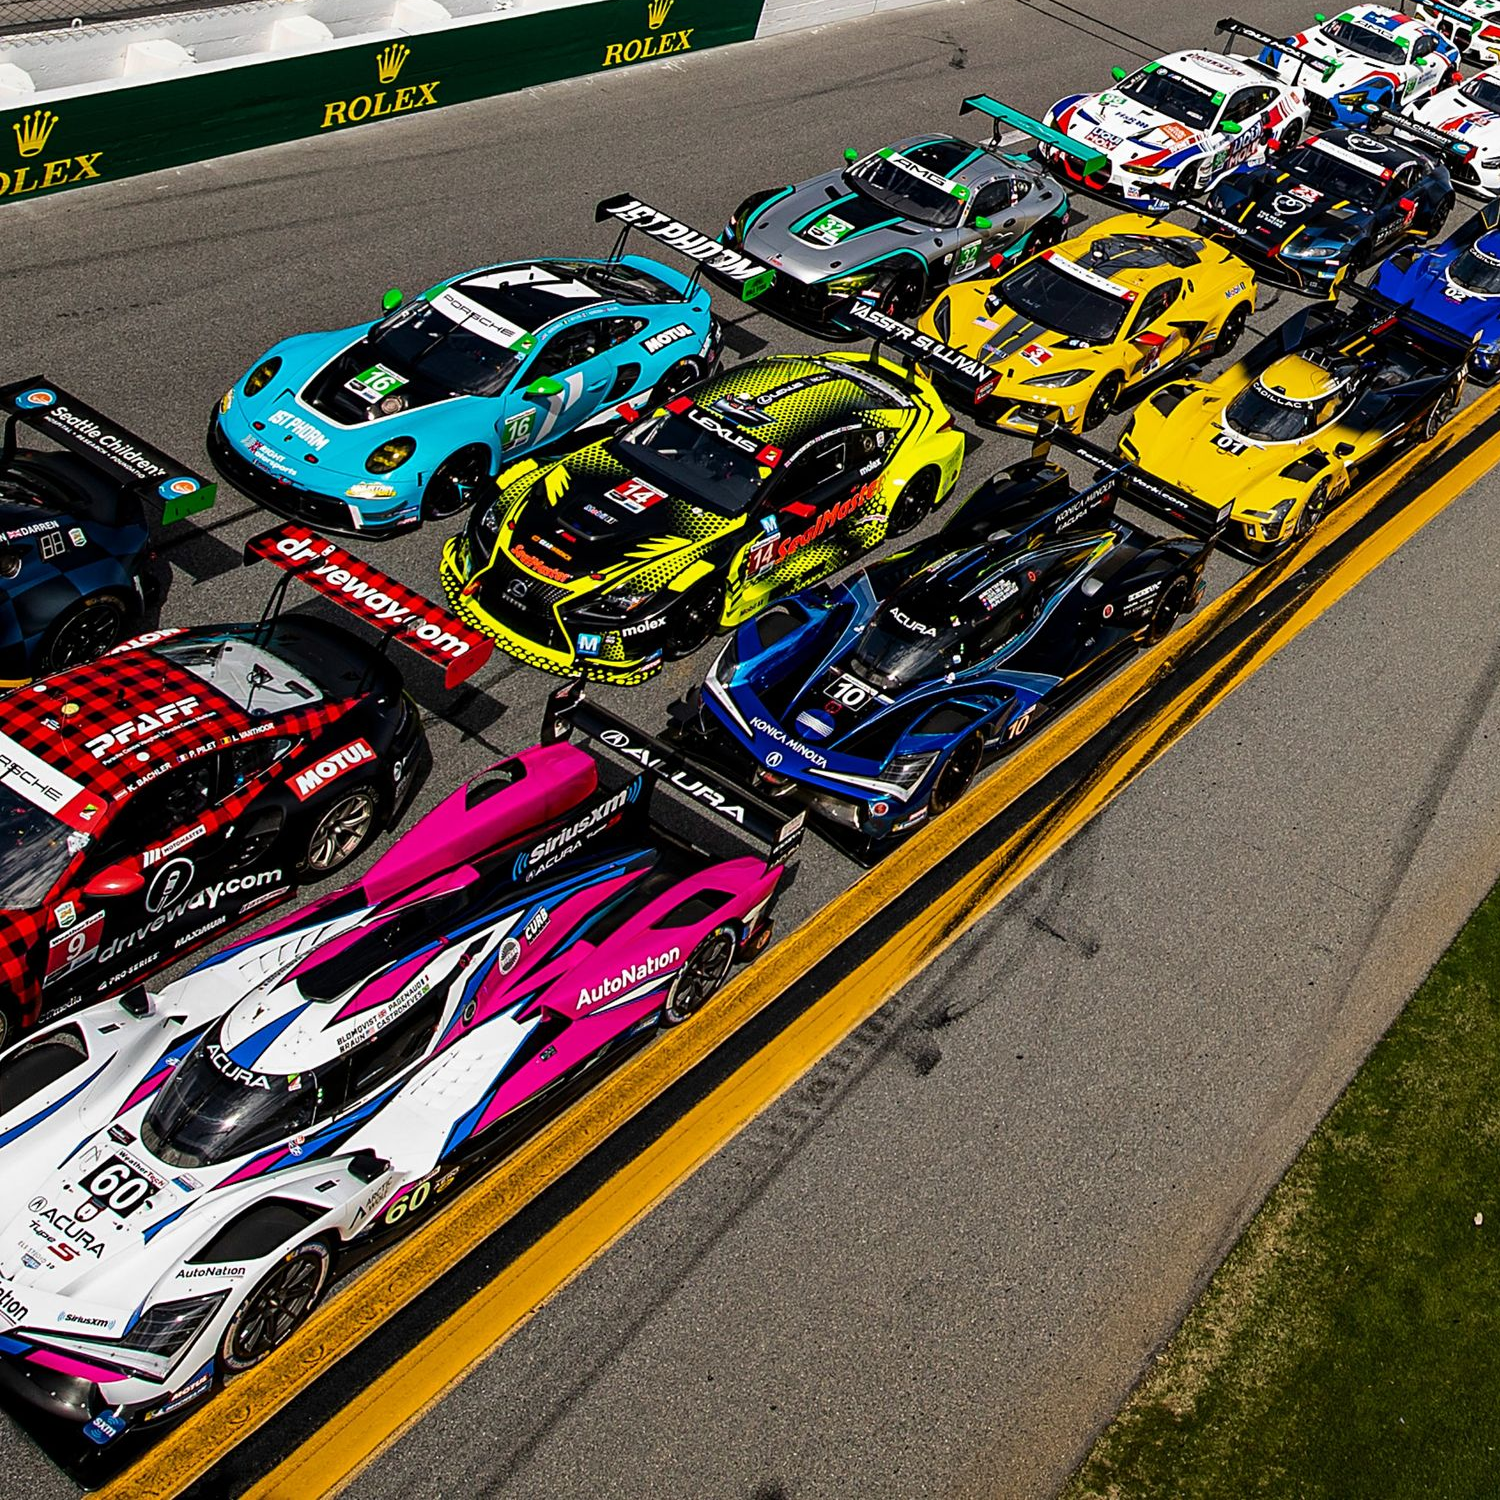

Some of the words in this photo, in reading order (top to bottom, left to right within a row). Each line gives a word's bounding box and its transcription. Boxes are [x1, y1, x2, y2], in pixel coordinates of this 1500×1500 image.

[603, 28, 692, 66] ROLEX
[320, 81, 440, 129] ROLEX
[1085, 133, 1118, 152] MOLY
[1092, 126, 1124, 145] LIQUI
[0, 152, 103, 197] LEX
[890, 156, 948, 187] AMG
[818, 218, 844, 237] 32
[960, 244, 977, 263] 32
[1444, 287, 1464, 302] 02
[441, 293, 517, 339] PORSCHE
[848, 300, 915, 341] VASSER
[645, 324, 693, 353] MOTUL
[1033, 346, 1046, 360] 3
[364, 370, 397, 392] 16
[769, 381, 804, 399] LEXUS
[1252, 381, 1303, 410] CADILLAC
[51, 405, 101, 439] Seattle
[285, 413, 331, 451] PHORM
[508, 415, 531, 442] 16
[687, 409, 759, 454] LEXUS
[44, 415, 73, 434] HOSPITAL
[75, 434, 109, 455] RESEARCH
[109, 454, 147, 480] FOUNDATIO
[1217, 434, 1249, 454] 01
[860, 457, 882, 477] molex
[624, 483, 650, 505] 14
[20, 520, 60, 537] DARREN
[764, 518, 778, 534] M
[774, 476, 886, 565] SealMaster
[753, 543, 774, 571] 14
[275, 536, 471, 658] drveway.om
[621, 615, 667, 638] molex
[889, 605, 938, 638] ACURA
[104, 627, 182, 657] MOTU
[835, 681, 866, 707] 10
[85, 696, 200, 759] PFAFF
[237, 722, 276, 741] VANTHOOR
[1008, 714, 1030, 739] 10
[195, 740, 217, 756] PILET
[750, 715, 787, 744] KONICA
[785, 736, 828, 770] MINOLTA
[0, 754, 63, 801] RSCHE
[136, 761, 173, 788] BACHLER
[295, 742, 372, 798] MOTUL
[163, 827, 205, 854] MOTOMASTER
[535, 839, 583, 877] ACURA
[98, 868, 284, 964] driveway.com
[524, 907, 550, 941] CURB
[66, 932, 86, 962] 9
[174, 915, 227, 949] MAXIMUM
[575, 946, 681, 1011] AutoNation
[375, 990, 423, 1031] CASTRONEVES
[338, 1032, 367, 1054] BRAUN
[206, 1043, 272, 1091] ACURA
[118, 1149, 166, 1188] WeatherTech
[89, 1163, 149, 1211] 60
[384, 1180, 432, 1226] 60
[28, 1218, 57, 1244] Type
[47, 1241, 81, 1263] S
[39, 1207, 107, 1260] ACURA
[174, 1264, 247, 1281] AutoNation
[171, 1373, 211, 1403] MOTUL
